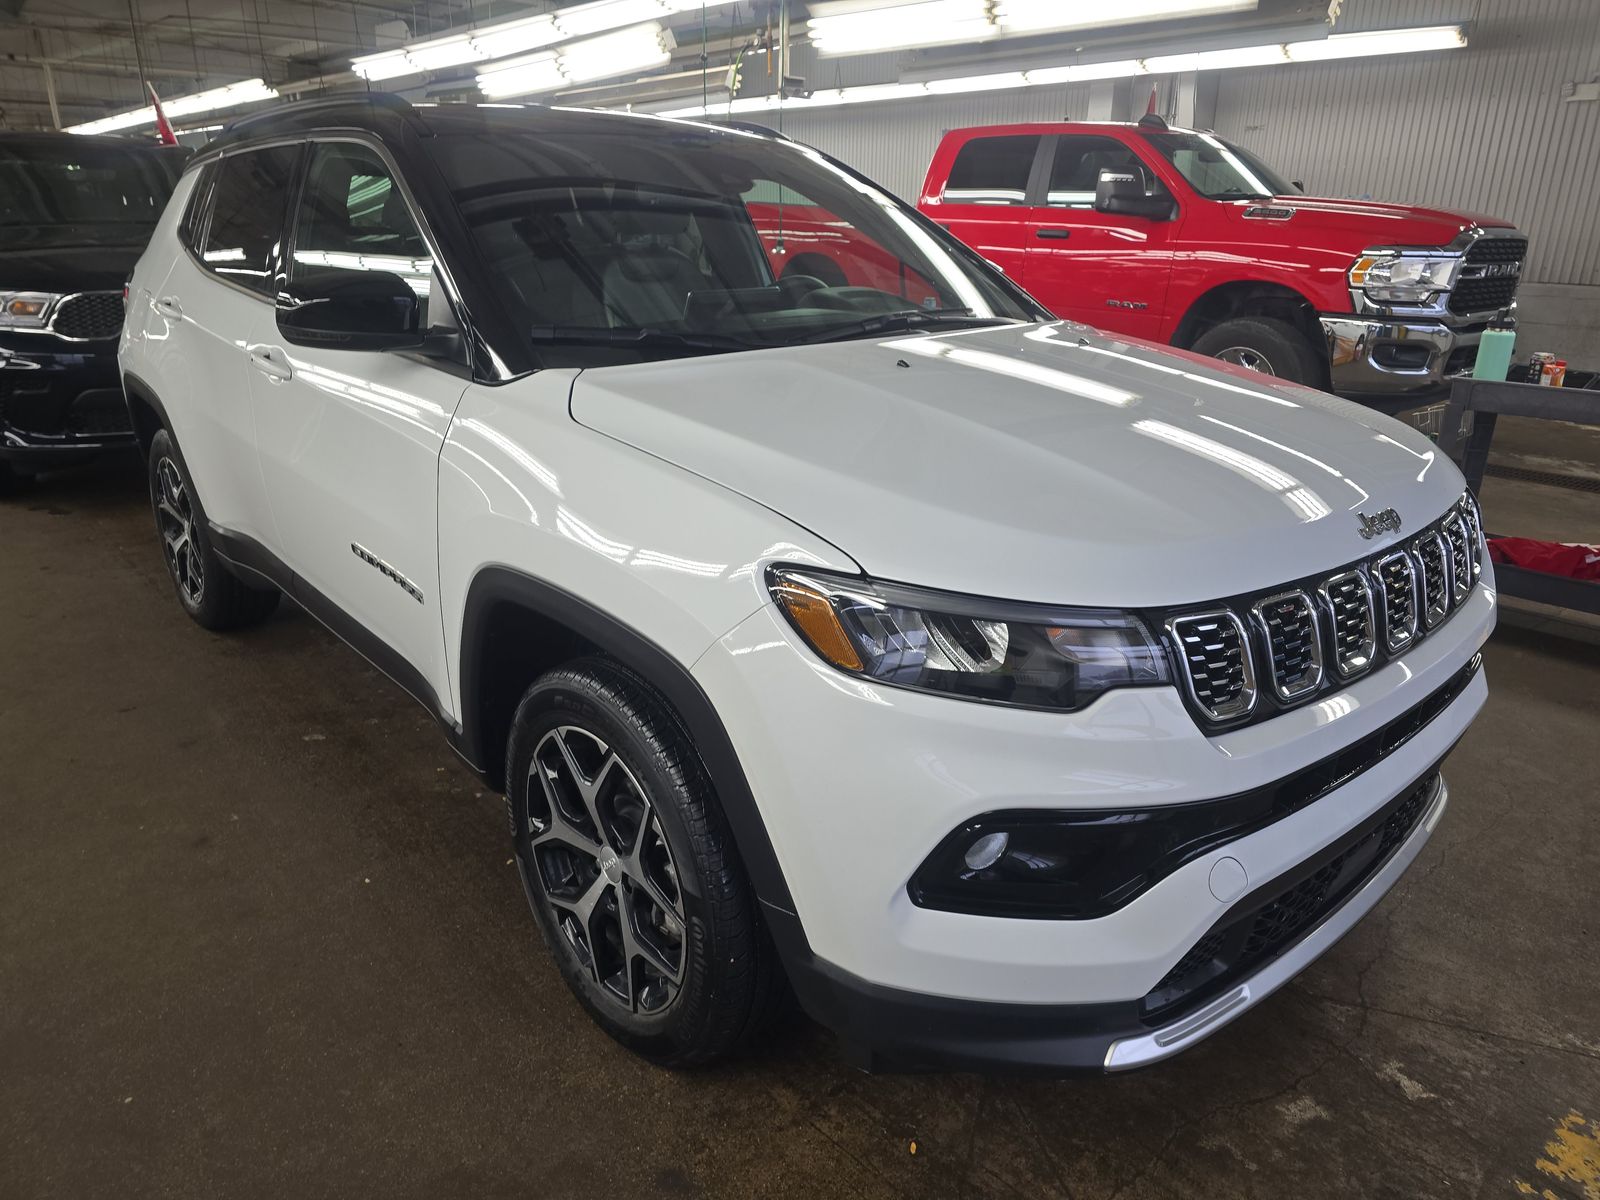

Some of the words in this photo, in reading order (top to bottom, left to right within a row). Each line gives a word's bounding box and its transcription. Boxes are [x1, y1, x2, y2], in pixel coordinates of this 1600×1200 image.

[1487, 263, 1519, 277] RAM
[1106, 299, 1149, 310] RAM
[1355, 507, 1402, 540] Jeep
[602, 856, 616, 871] Jeep
